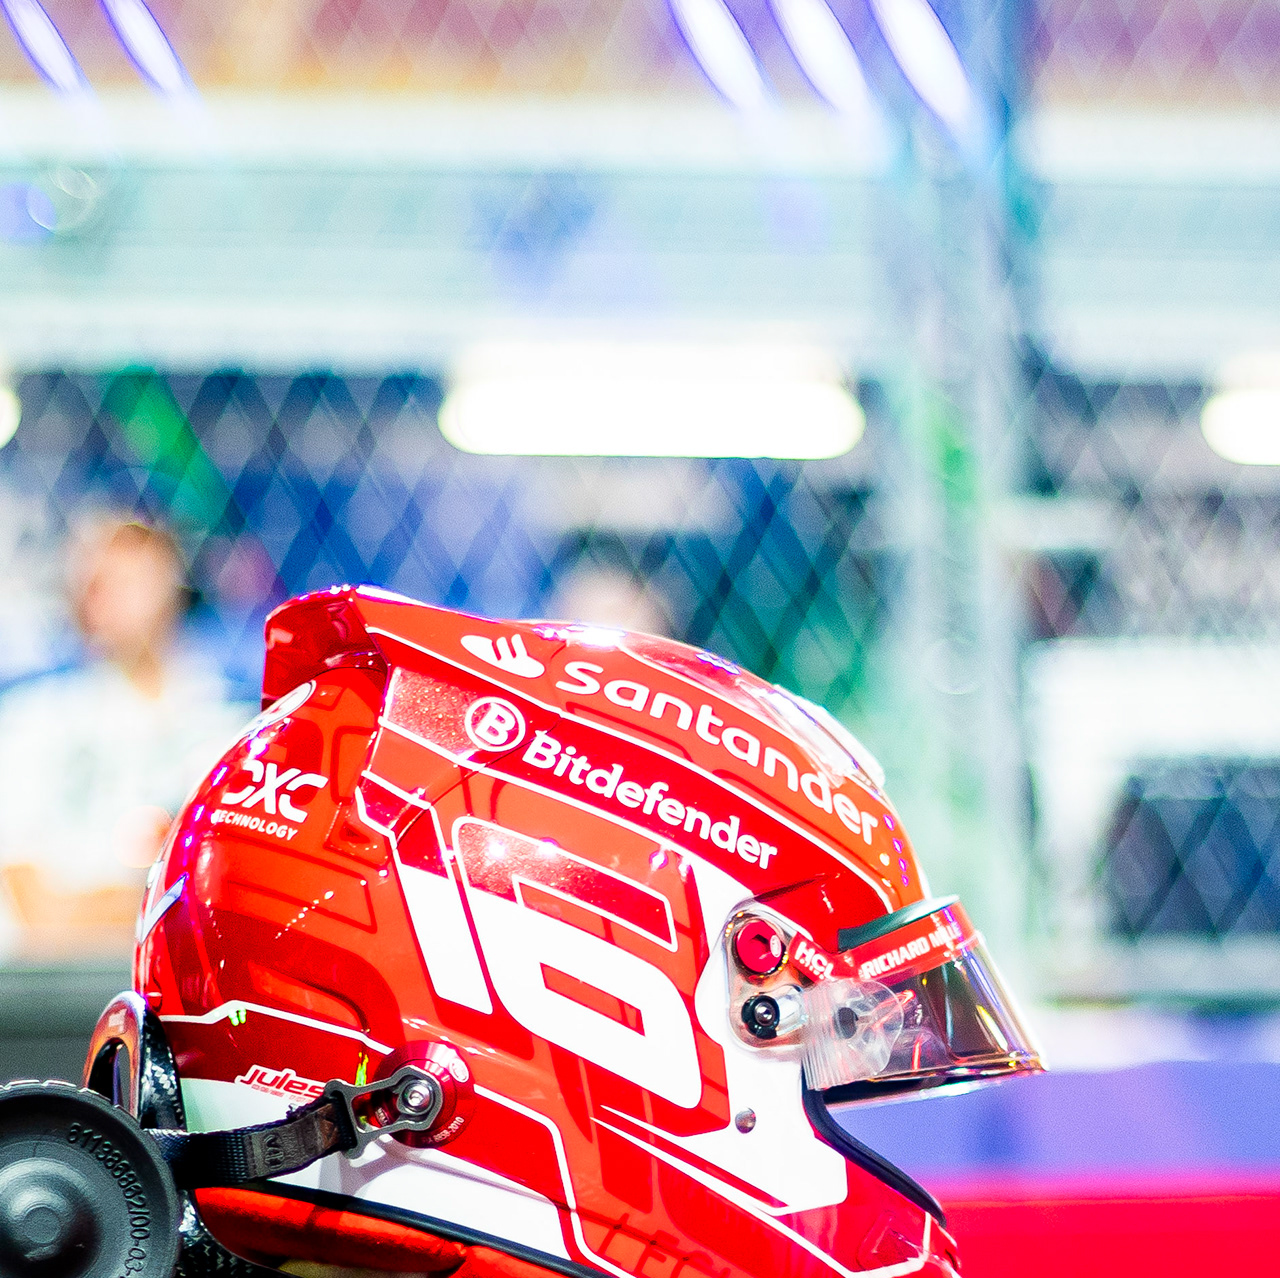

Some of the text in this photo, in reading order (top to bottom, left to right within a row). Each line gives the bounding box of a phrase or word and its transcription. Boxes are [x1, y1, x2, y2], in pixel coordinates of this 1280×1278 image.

[522, 727, 778, 870] Bitdefender
[555, 660, 879, 846] Santander
[210, 808, 299, 841] TECHNOLOGY
[388, 808, 704, 1109] 16
[859, 935, 931, 980] RICHARD
[239, 1067, 325, 1100] jules
